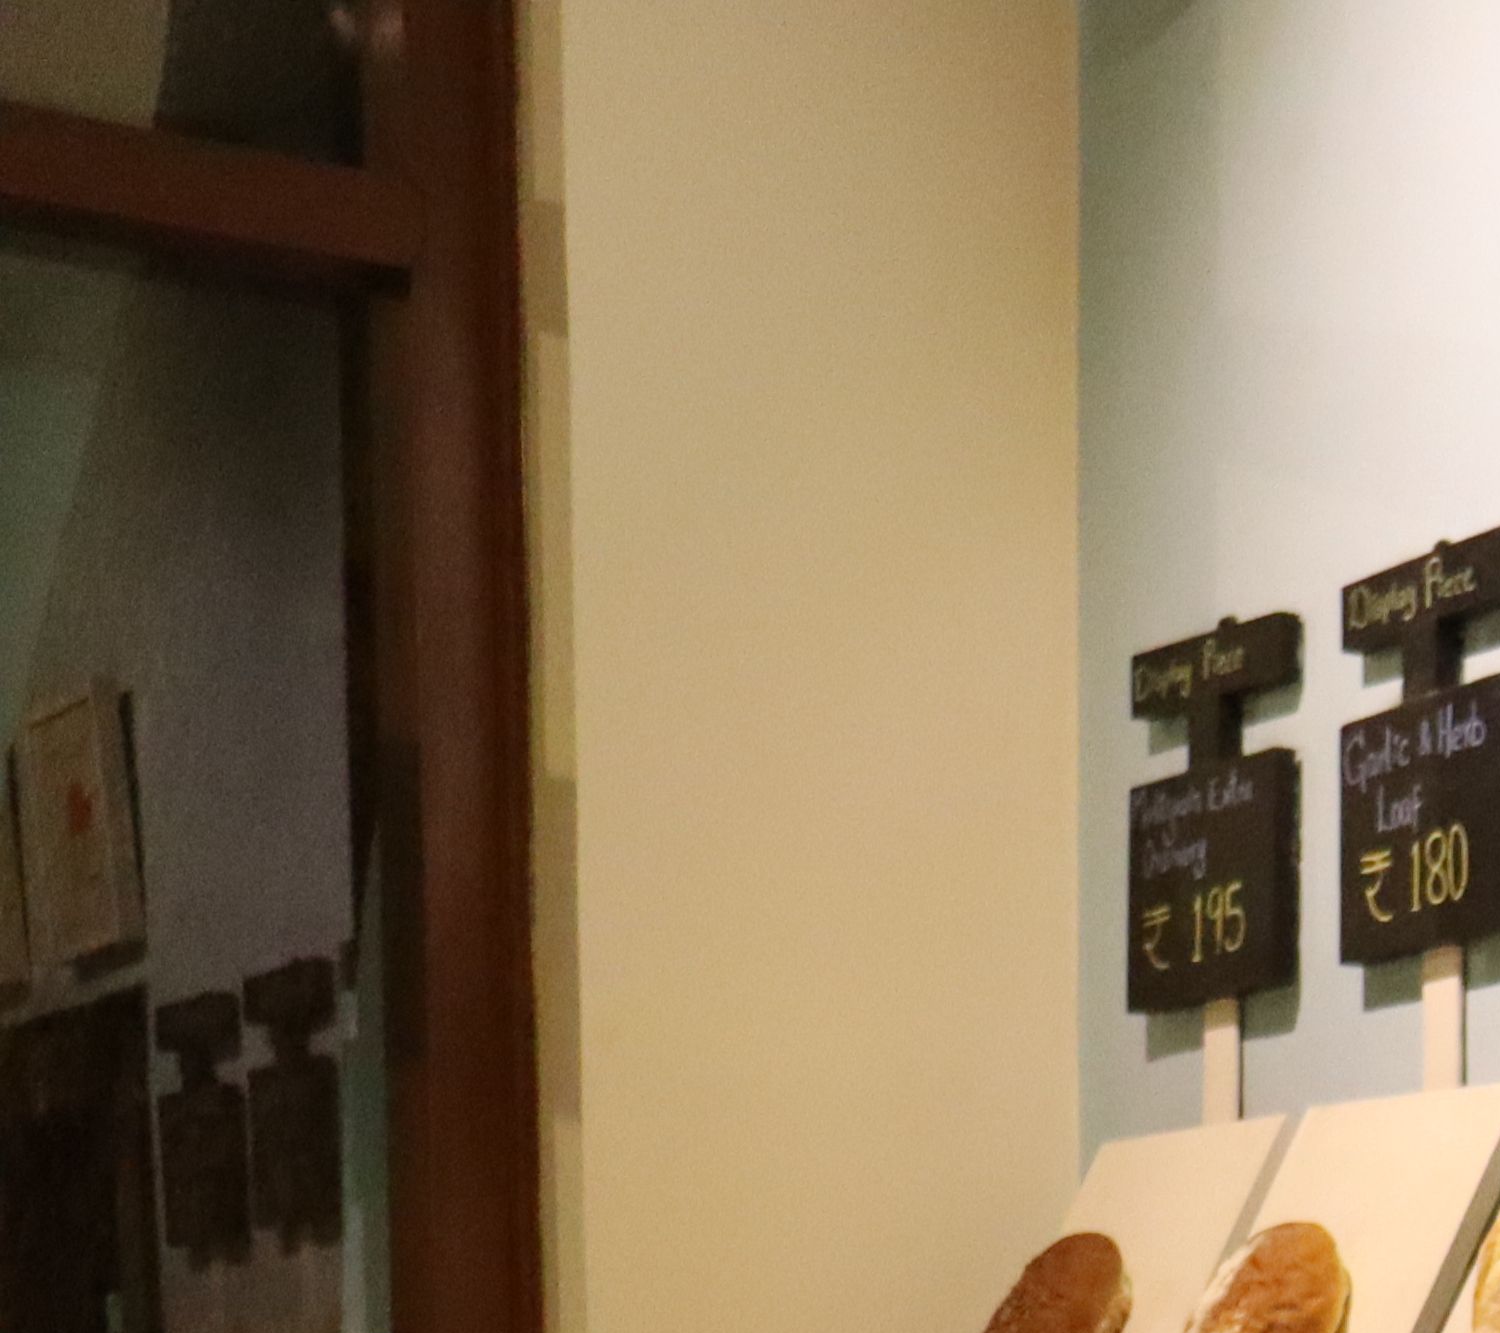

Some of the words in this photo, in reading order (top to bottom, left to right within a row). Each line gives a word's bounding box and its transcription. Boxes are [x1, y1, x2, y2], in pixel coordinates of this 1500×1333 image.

[1377, 783, 1423, 833] Loaf
[1360, 849, 1394, 922] ₹
[1410, 823, 1469, 912] 180
[1192, 879, 1246, 963] 195
